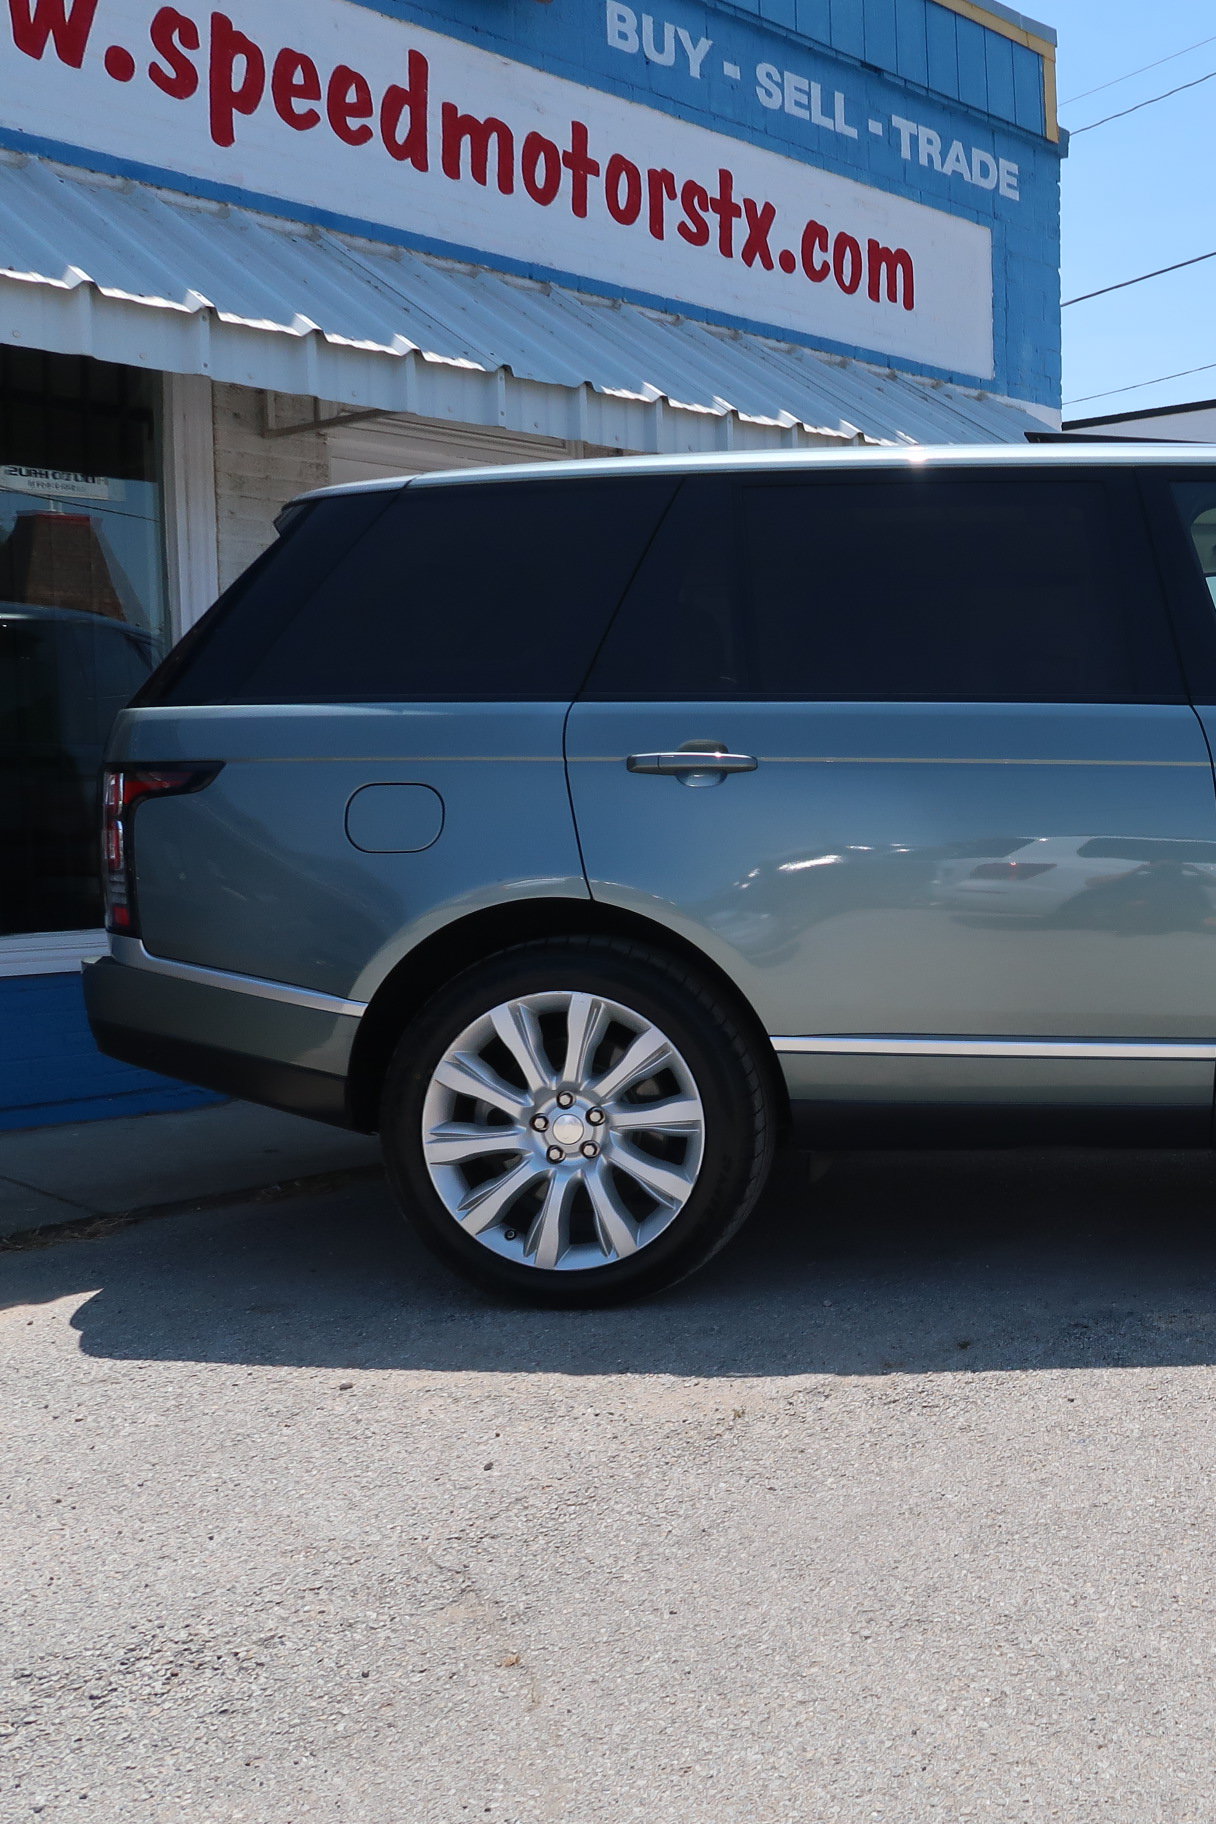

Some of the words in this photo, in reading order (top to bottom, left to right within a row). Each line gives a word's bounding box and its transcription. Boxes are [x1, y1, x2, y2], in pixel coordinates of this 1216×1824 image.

[8, 0, 915, 311] w.speedmotorstx.com
[607, 1, 713, 79] BUY
[755, 62, 858, 139] SELL
[892, 114, 1020, 201] TRADE
